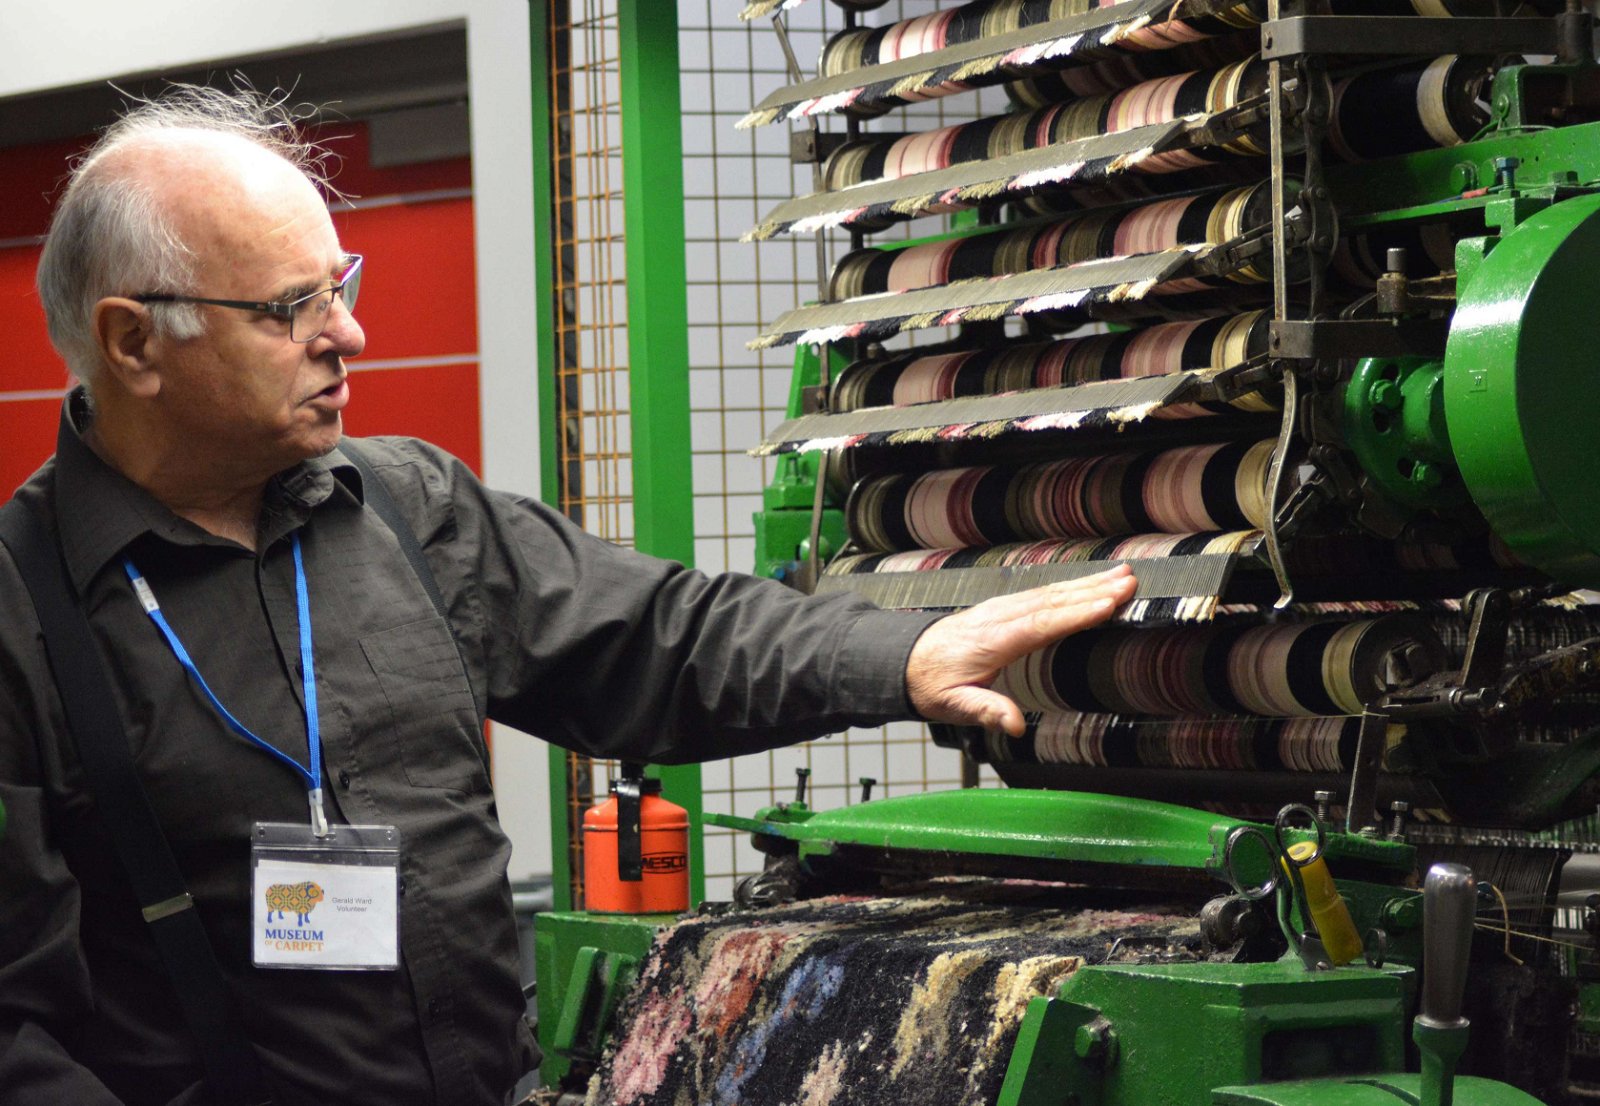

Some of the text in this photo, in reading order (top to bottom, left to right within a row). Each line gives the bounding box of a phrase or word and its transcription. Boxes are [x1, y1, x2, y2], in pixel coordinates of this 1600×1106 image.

[354, 897, 372, 905] Ward
[265, 929, 324, 941] MUSEUM
[275, 940, 324, 952] CARPET
